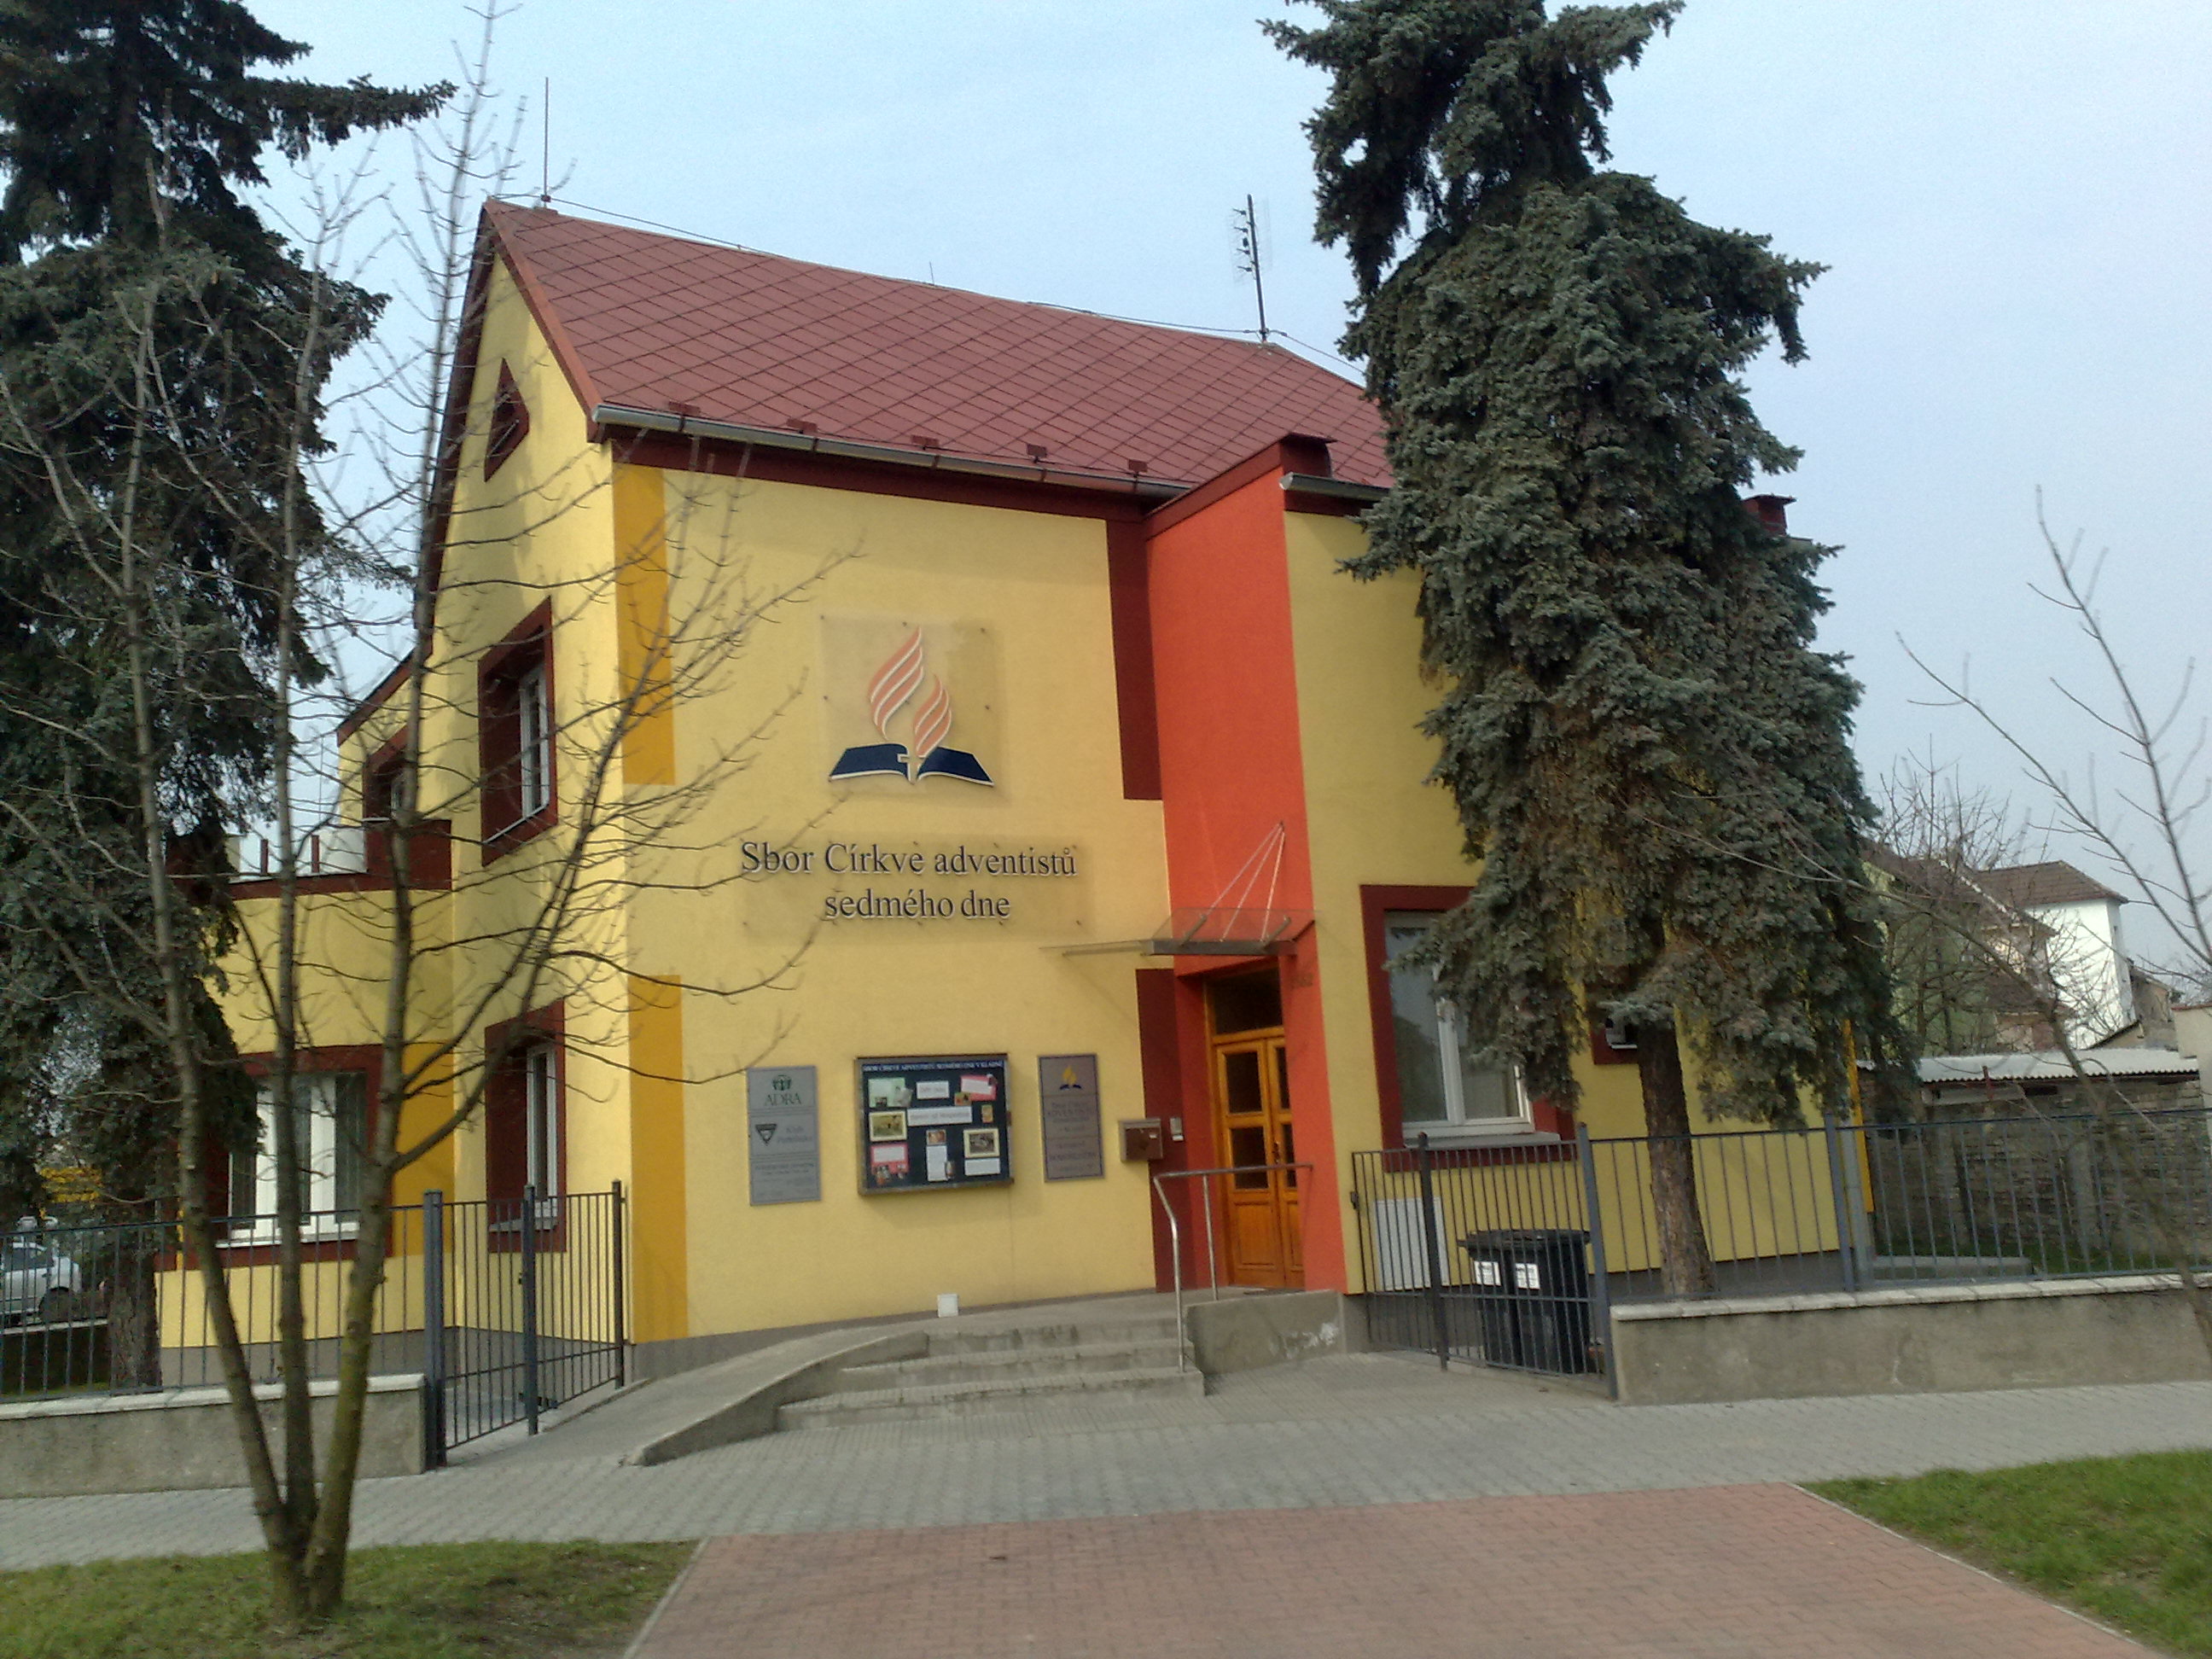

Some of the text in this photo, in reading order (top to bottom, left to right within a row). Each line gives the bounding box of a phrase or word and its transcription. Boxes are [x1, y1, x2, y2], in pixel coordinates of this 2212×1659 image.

[741, 841, 1078, 876] Sbor Církve adventistů
[825, 888, 1011, 919] sedmého dne
[765, 1092, 802, 1106] ADRA
